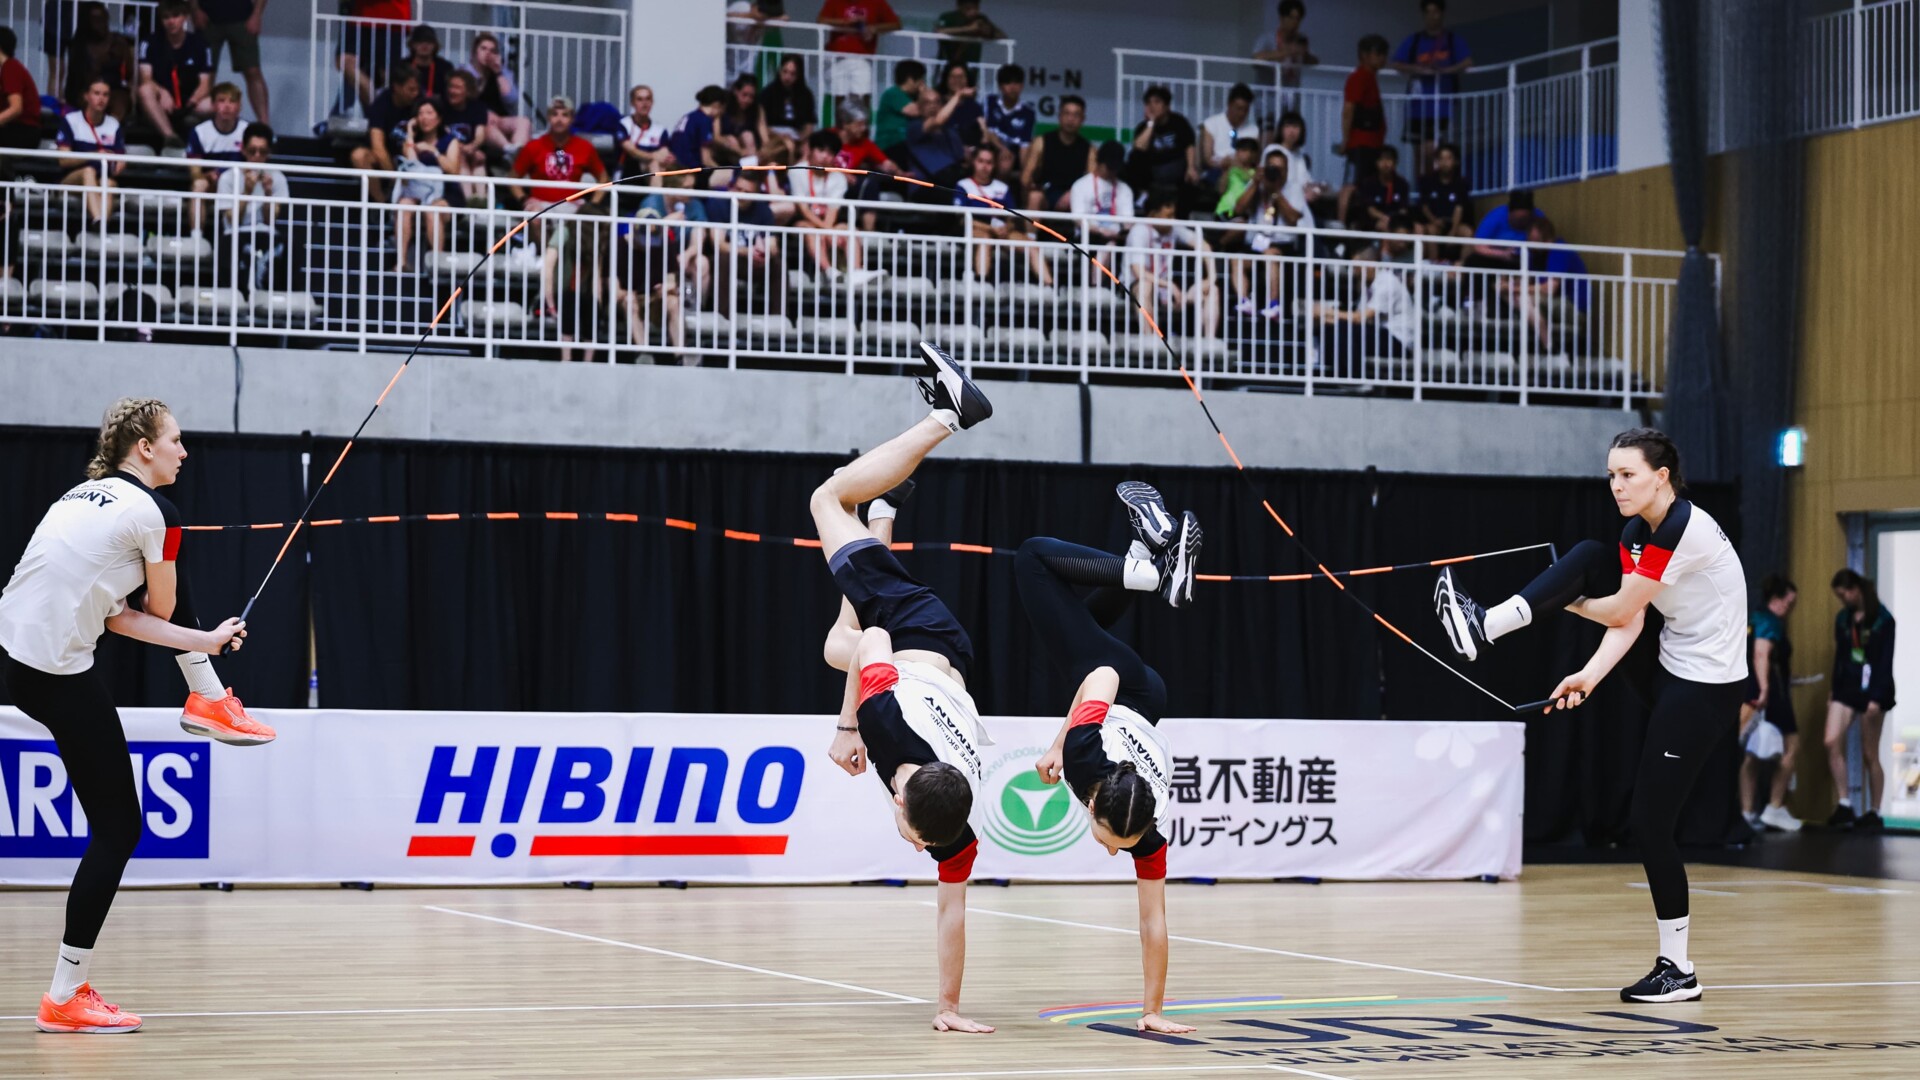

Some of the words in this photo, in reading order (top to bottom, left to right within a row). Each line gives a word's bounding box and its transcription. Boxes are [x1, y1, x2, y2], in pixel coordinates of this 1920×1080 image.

[1087, 1011, 1719, 1046] IJRU
[1207, 1035, 1815, 1057] INTERNATIONAL
[1267, 1053, 1472, 1065] JUMP
[1484, 1047, 1703, 1059] ROPE
